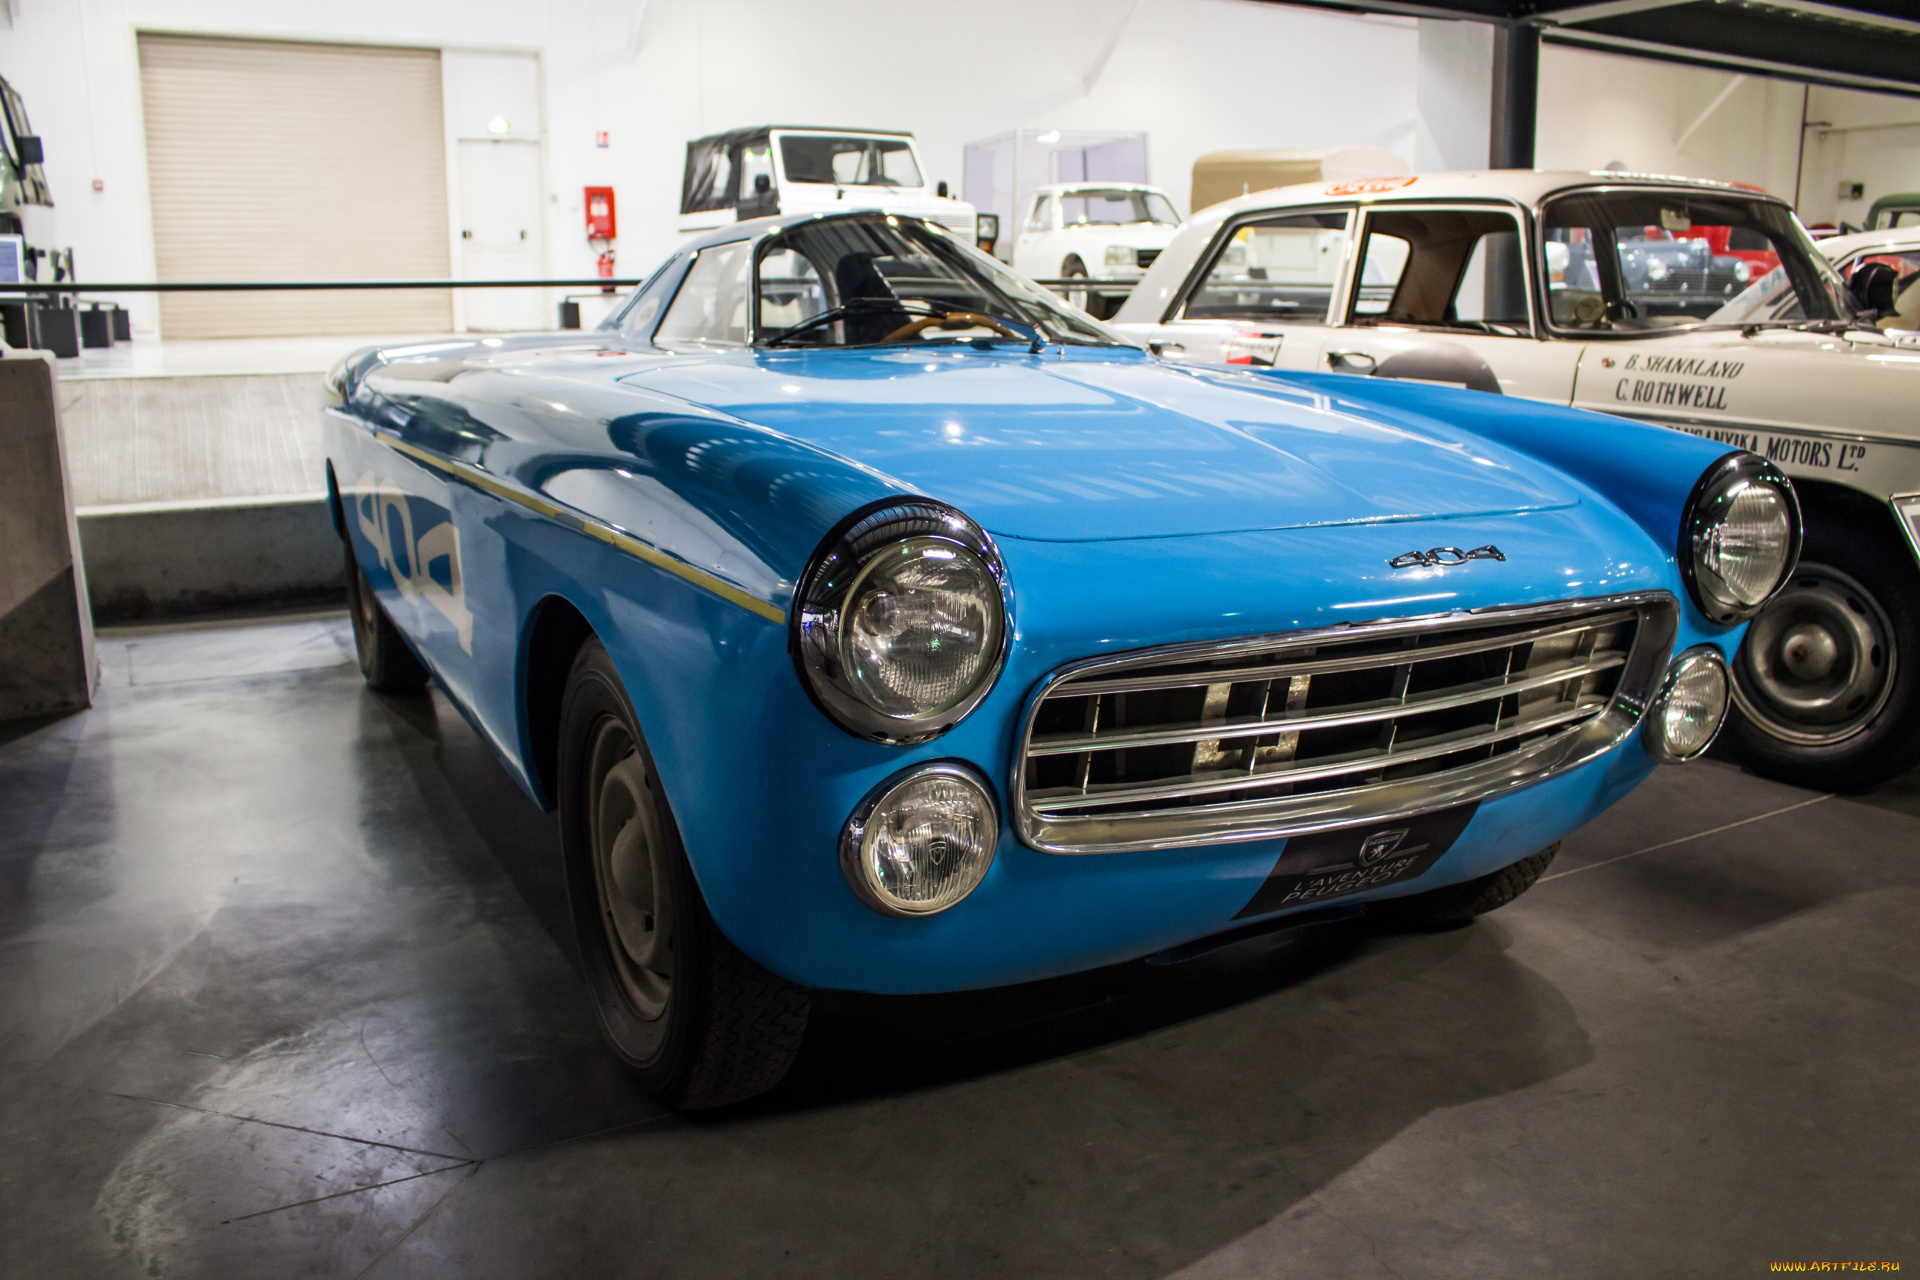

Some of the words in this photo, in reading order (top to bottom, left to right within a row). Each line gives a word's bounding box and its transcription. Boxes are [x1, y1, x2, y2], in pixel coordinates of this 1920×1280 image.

[1615, 378, 1628, 401] C.
[1631, 380, 1727, 411] ROTHWELL
[1765, 436, 1833, 467] MOTORS
[1388, 544, 1507, 569] 404
[1281, 866, 1410, 904] PEUGEOT
[1294, 856, 1419, 892] L'AVENTURE
